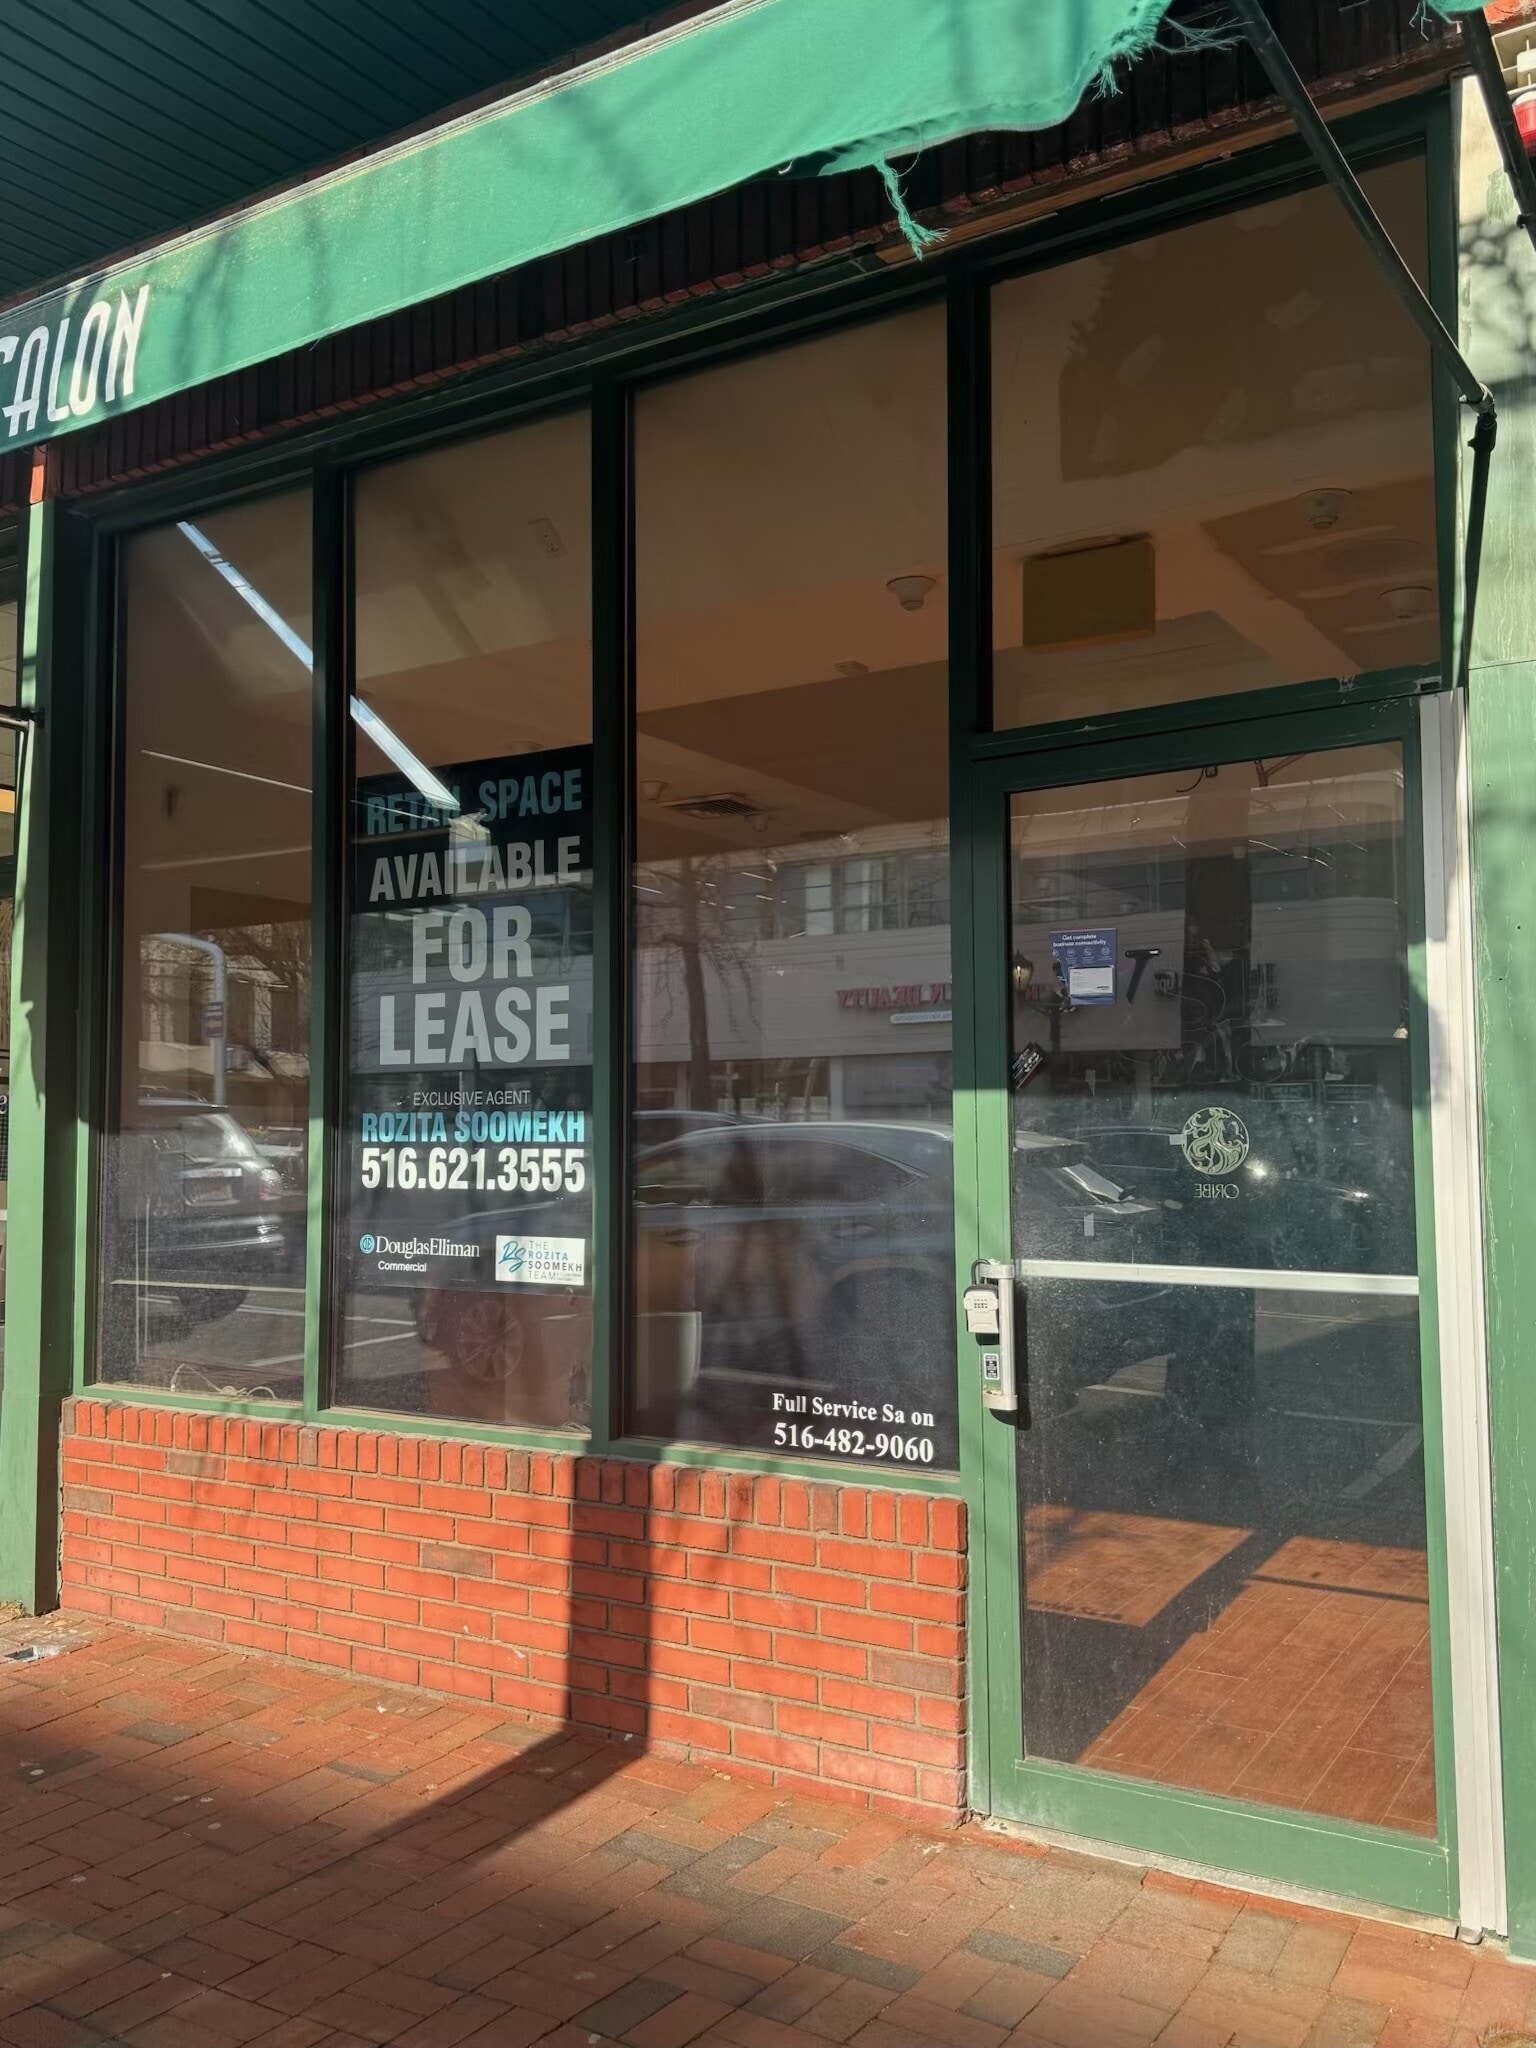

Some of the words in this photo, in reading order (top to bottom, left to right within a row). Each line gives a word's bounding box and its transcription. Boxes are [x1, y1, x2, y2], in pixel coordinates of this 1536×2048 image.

[478, 768, 583, 823] SPACE
[369, 835, 582, 902] AVAILABLE
[412, 905, 534, 984] FOR
[379, 985, 570, 1065] LEASE
[413, 1090, 483, 1106] EXCLUSIVE
[486, 1089, 531, 1105] AGENT
[361, 1111, 448, 1143] ROZITA
[454, 1110, 585, 1143] SOOMEKH
[361, 1147, 586, 1193] 516.621.3555
[528, 1240, 549, 1250] THE
[528, 1250, 569, 1261] ROZITA
[377, 1260, 427, 1272] Commercial
[528, 1260, 582, 1272] SOOMEKH
[528, 1270, 556, 1281] TEAM
[772, 1392, 807, 1413] Full
[812, 1397, 877, 1421] Service
[774, 1421, 934, 1463] 516-482-9060
